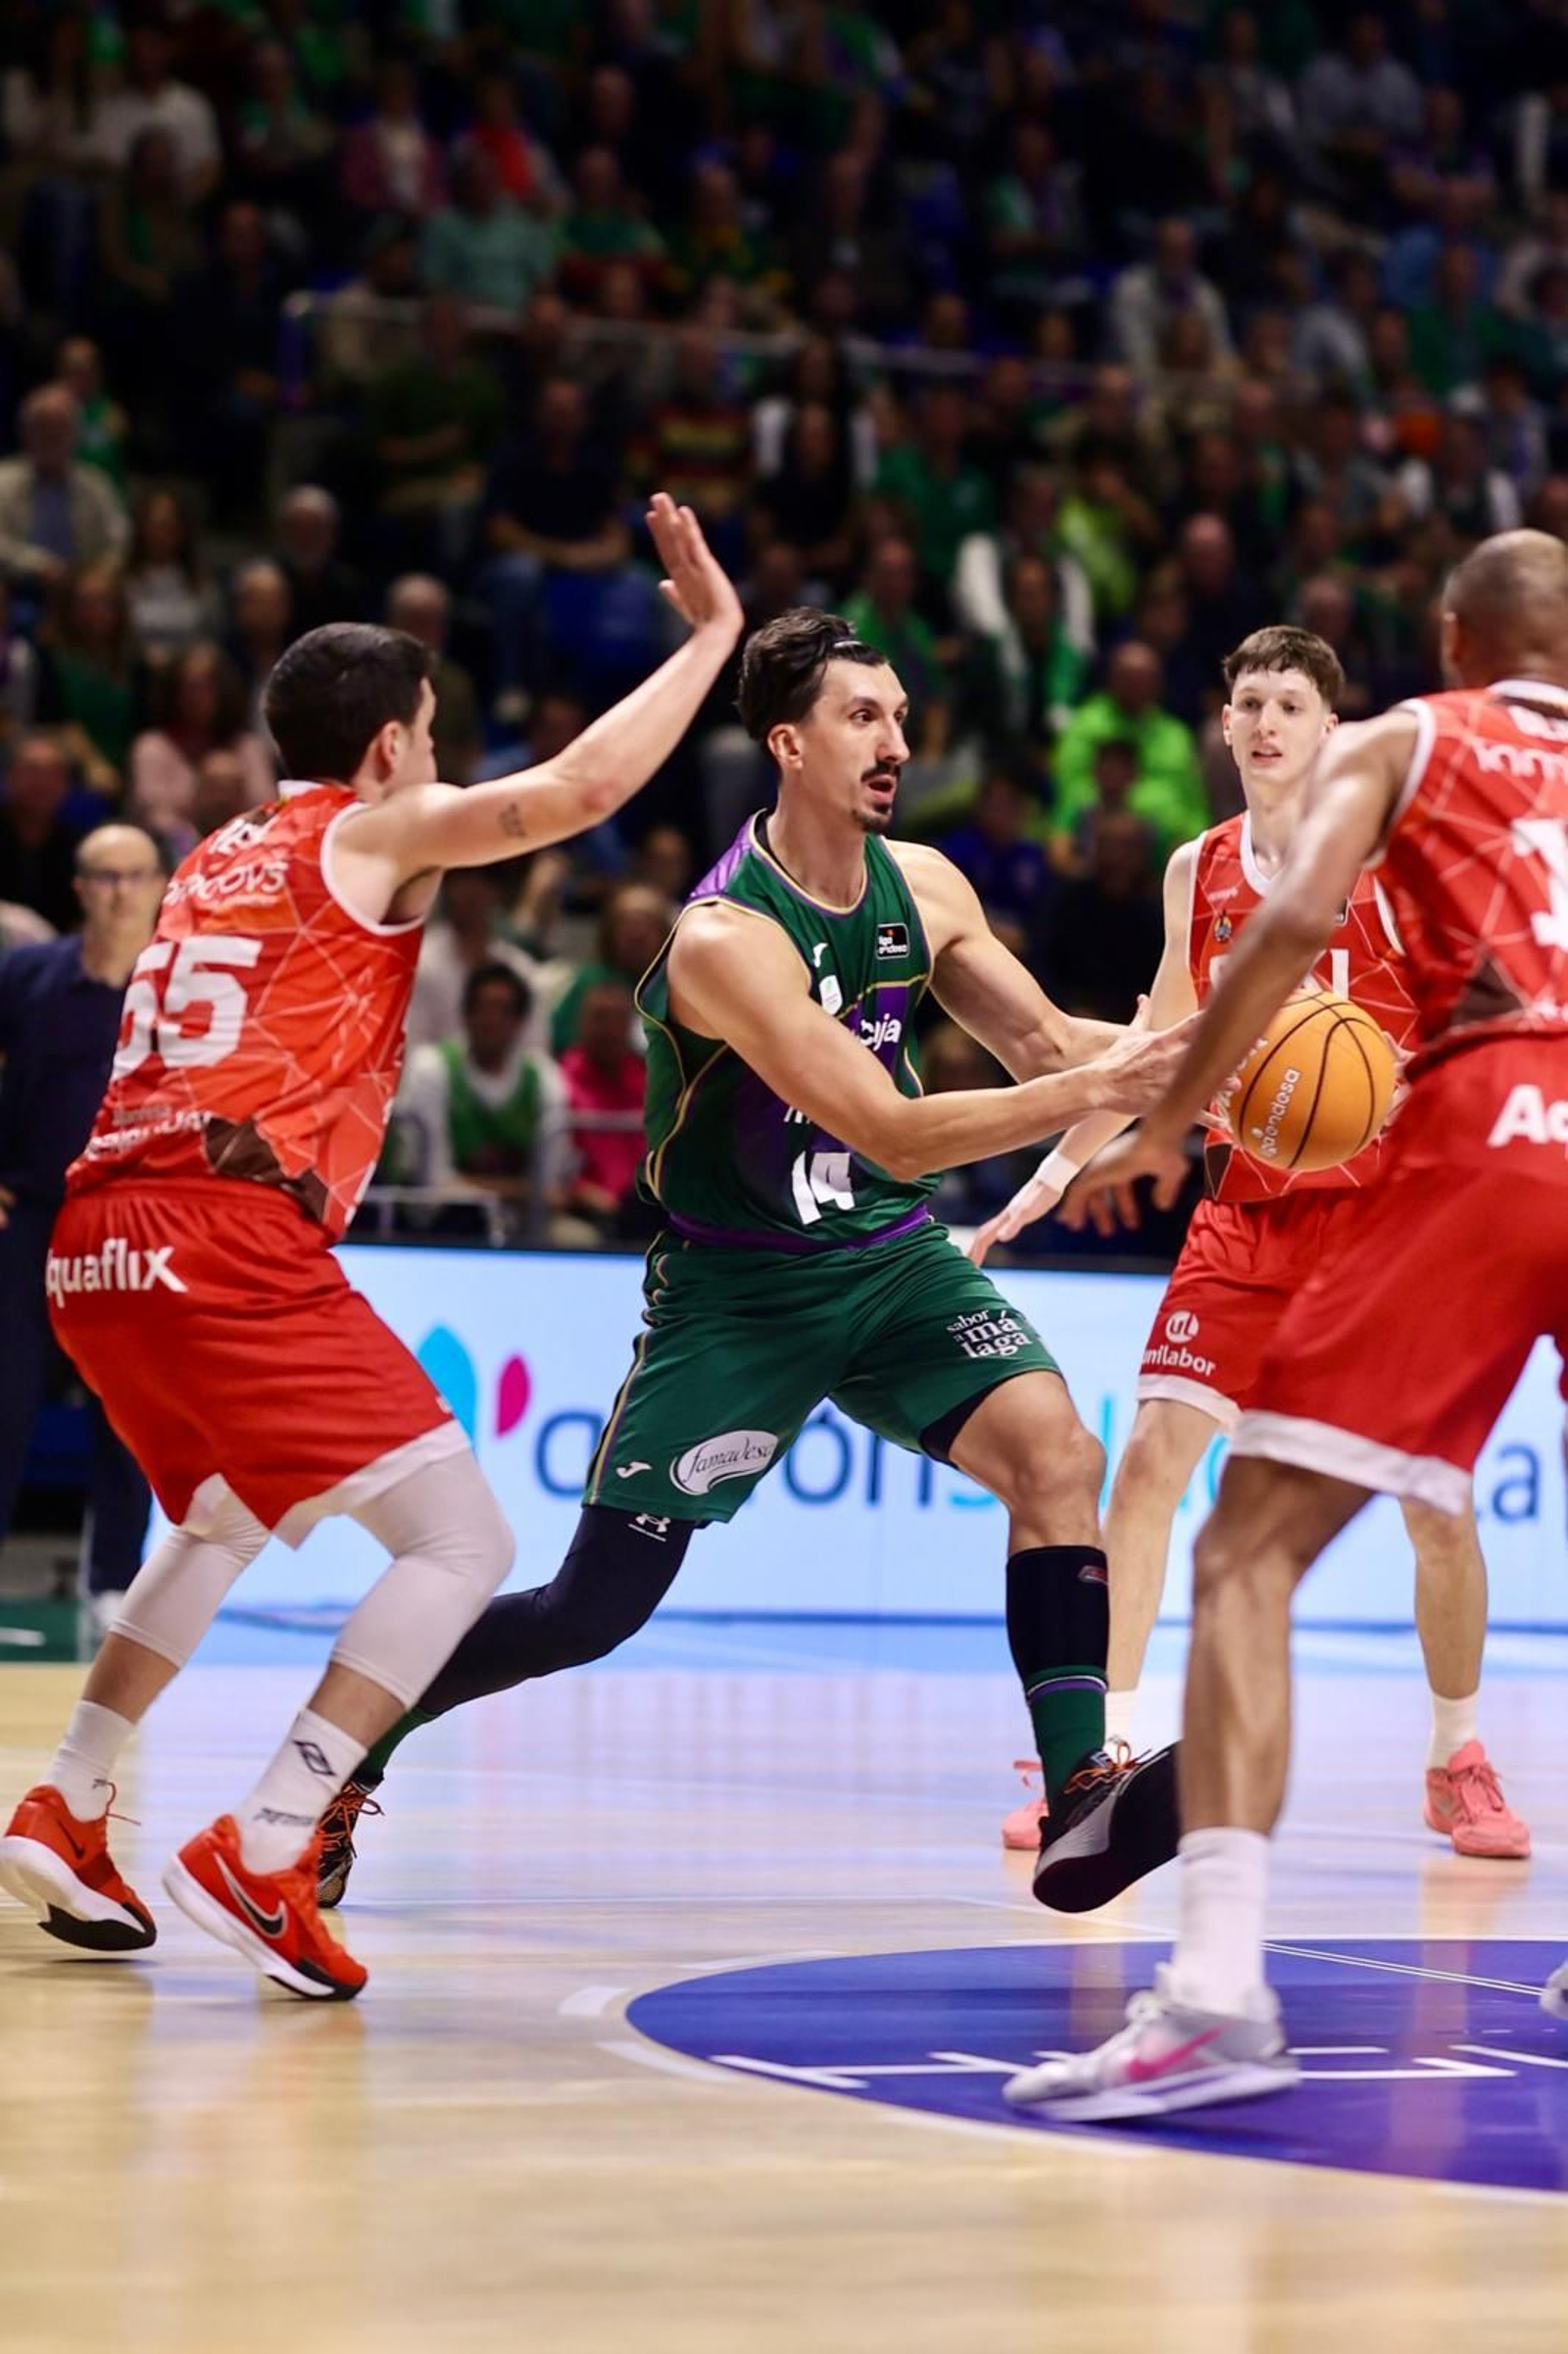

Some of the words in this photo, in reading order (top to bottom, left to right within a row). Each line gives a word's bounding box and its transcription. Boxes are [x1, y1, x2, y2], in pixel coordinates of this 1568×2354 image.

[110, 935, 264, 1082] 55
[45, 1238, 188, 1308] quaflix
[947, 1309, 989, 1331] sabor
[963, 1309, 1022, 1343] má
[961, 1333, 1033, 1358] laga
